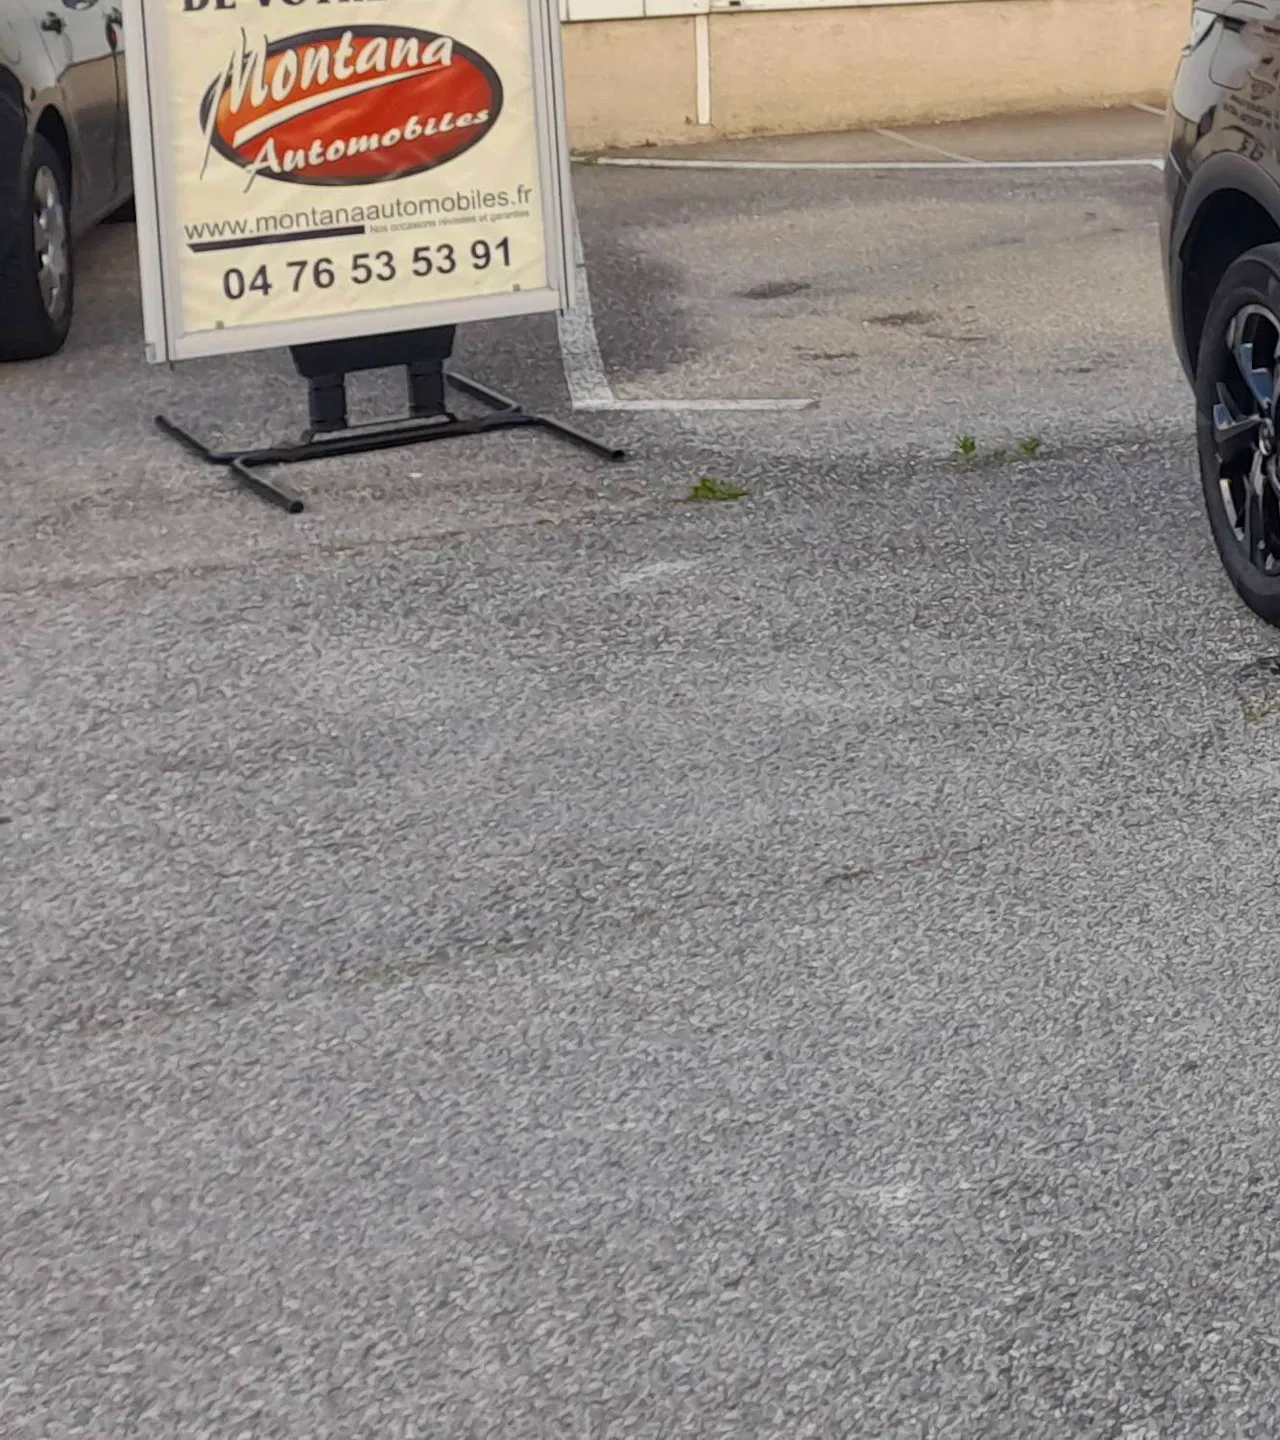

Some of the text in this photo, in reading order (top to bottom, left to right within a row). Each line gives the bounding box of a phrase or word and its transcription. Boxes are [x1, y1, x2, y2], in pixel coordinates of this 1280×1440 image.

[202, 27, 454, 132] Montana
[243, 109, 491, 184] Automobiles
[184, 184, 533, 241] www.montanaautomobiles.fr
[223, 236, 511, 300] 04 76 53 53 91
